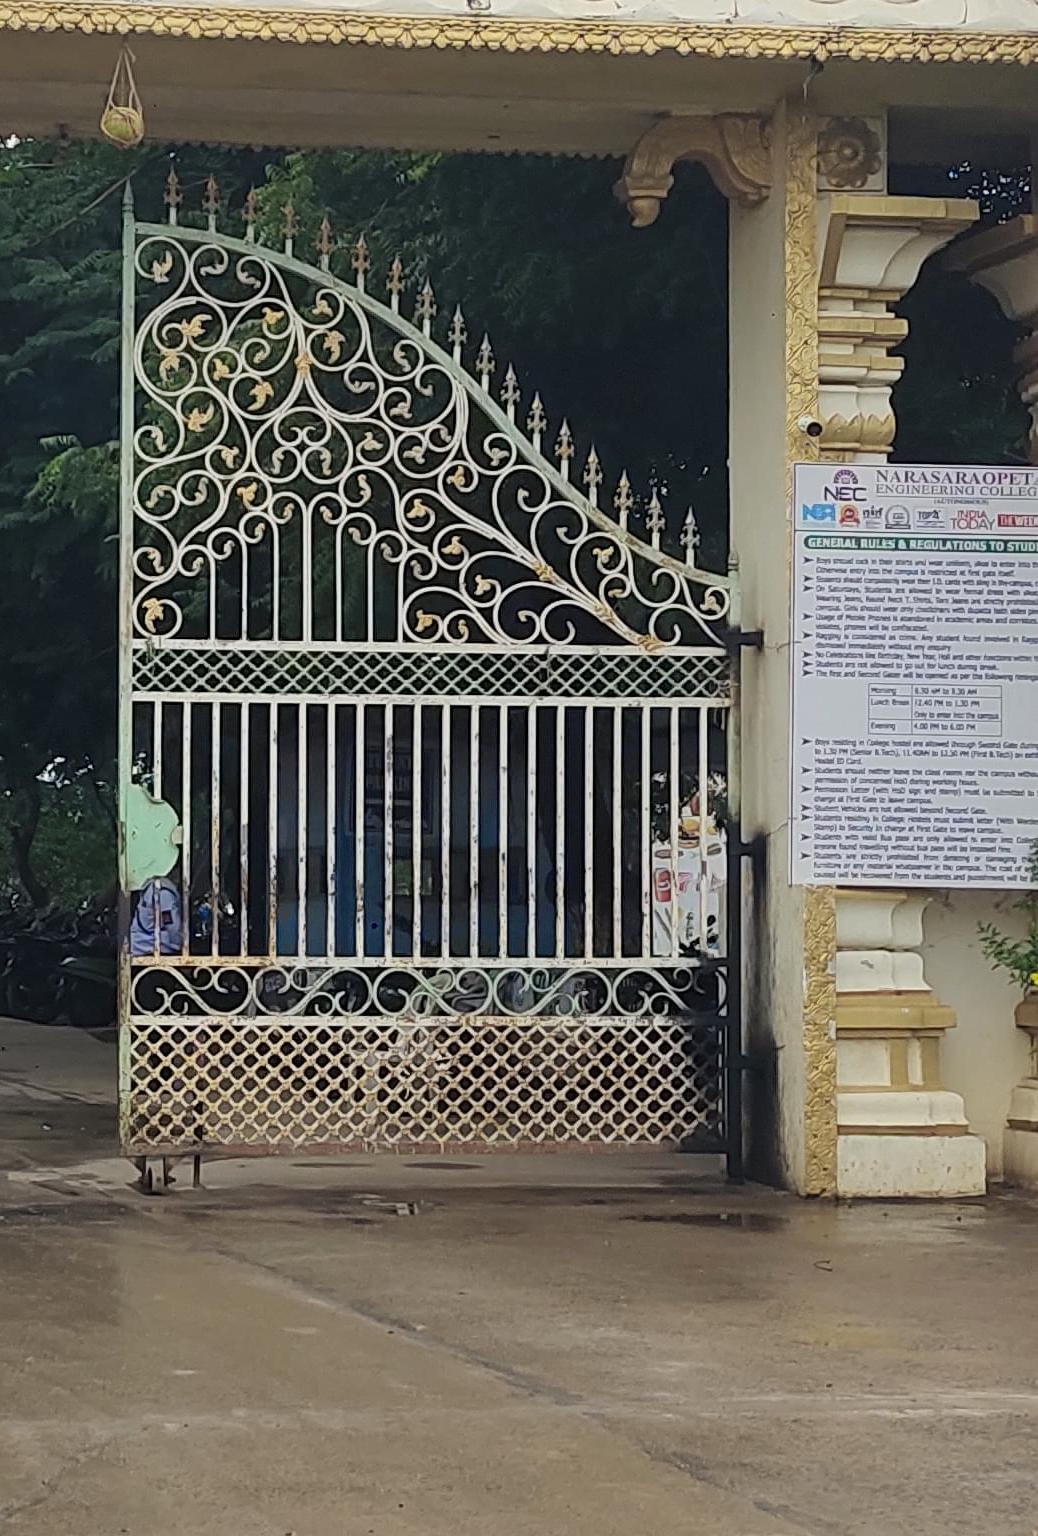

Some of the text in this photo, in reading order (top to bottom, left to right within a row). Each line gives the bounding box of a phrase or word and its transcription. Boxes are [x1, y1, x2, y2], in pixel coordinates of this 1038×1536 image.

[876, 470, 1038, 485] NARASARAOPET
[824, 486, 867, 501] NEC
[876, 484, 1038, 497] ENGINEERING COLLEG
[957, 510, 987, 519] INDIA
[950, 518, 995, 530] TODAY
[808, 538, 858, 549] GENERAL
[861, 539, 896, 549] RULES
[909, 540, 987, 551] REGULATIONS
[989, 542, 1004, 551] TO
